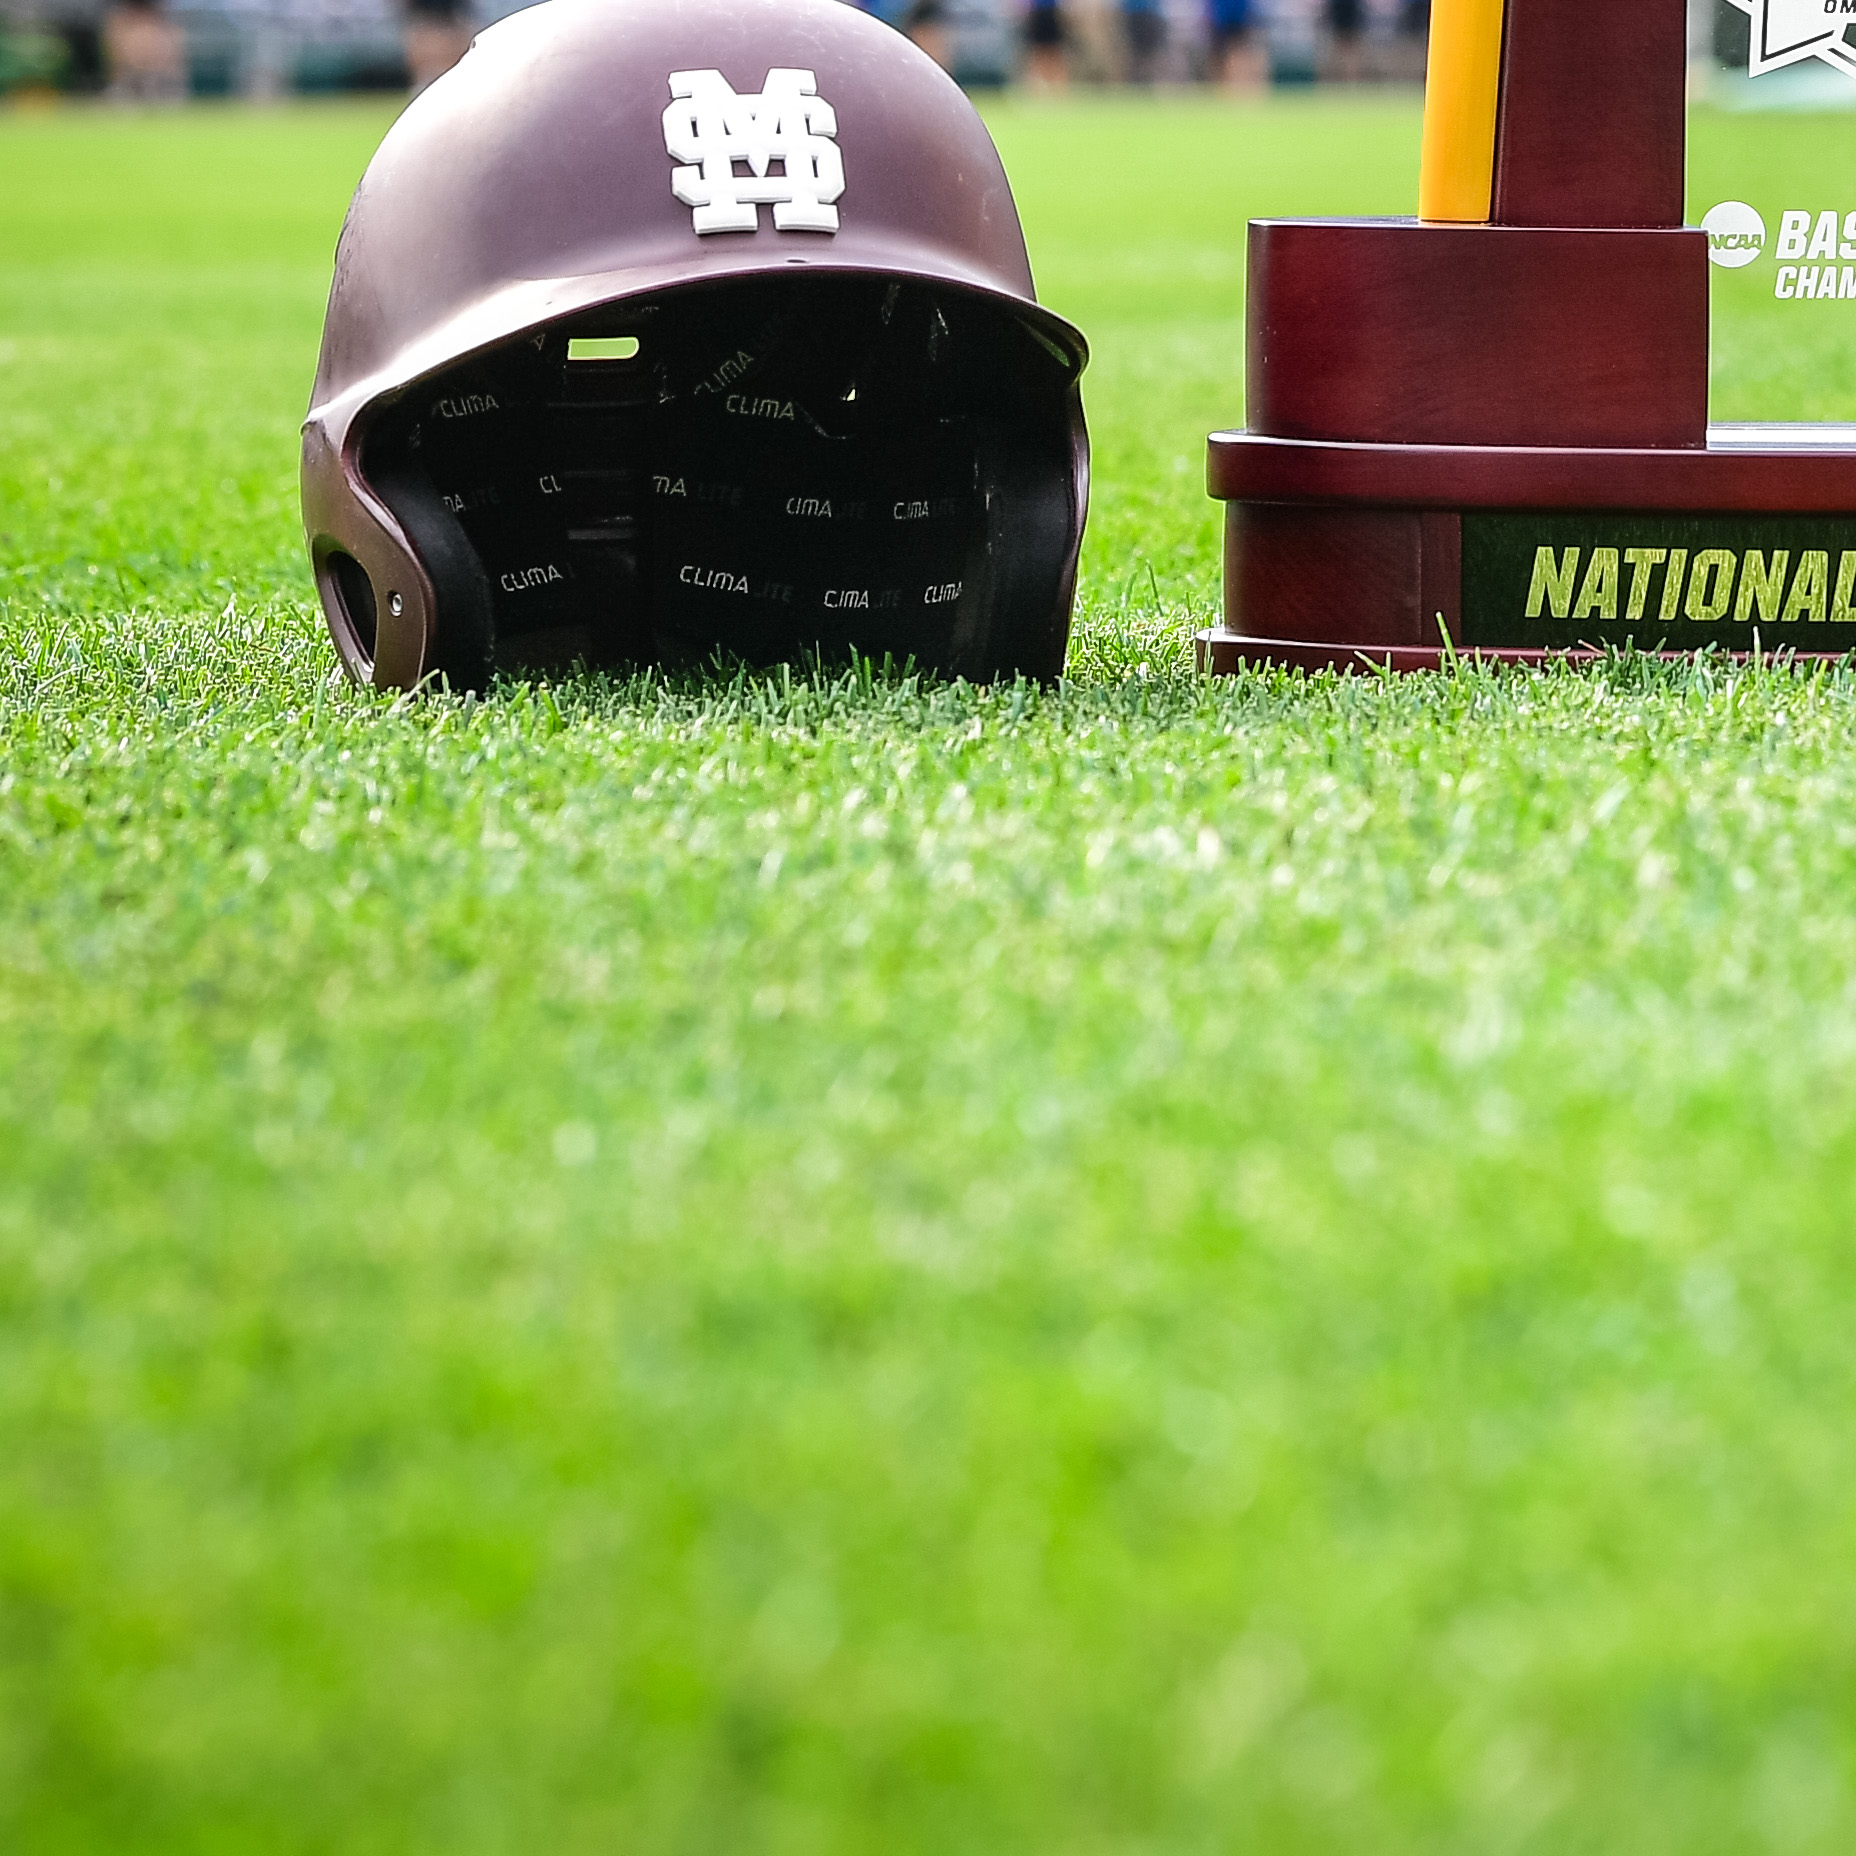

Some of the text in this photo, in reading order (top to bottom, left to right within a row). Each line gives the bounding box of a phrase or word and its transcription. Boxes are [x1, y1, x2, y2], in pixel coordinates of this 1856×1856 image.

[1709, 233, 1763, 250] NCAA
[439, 393, 500, 419] CLIMA
[726, 394, 795, 421] CLIMA
[500, 564, 563, 592] CLIMA
[679, 565, 749, 594] CLIMA
